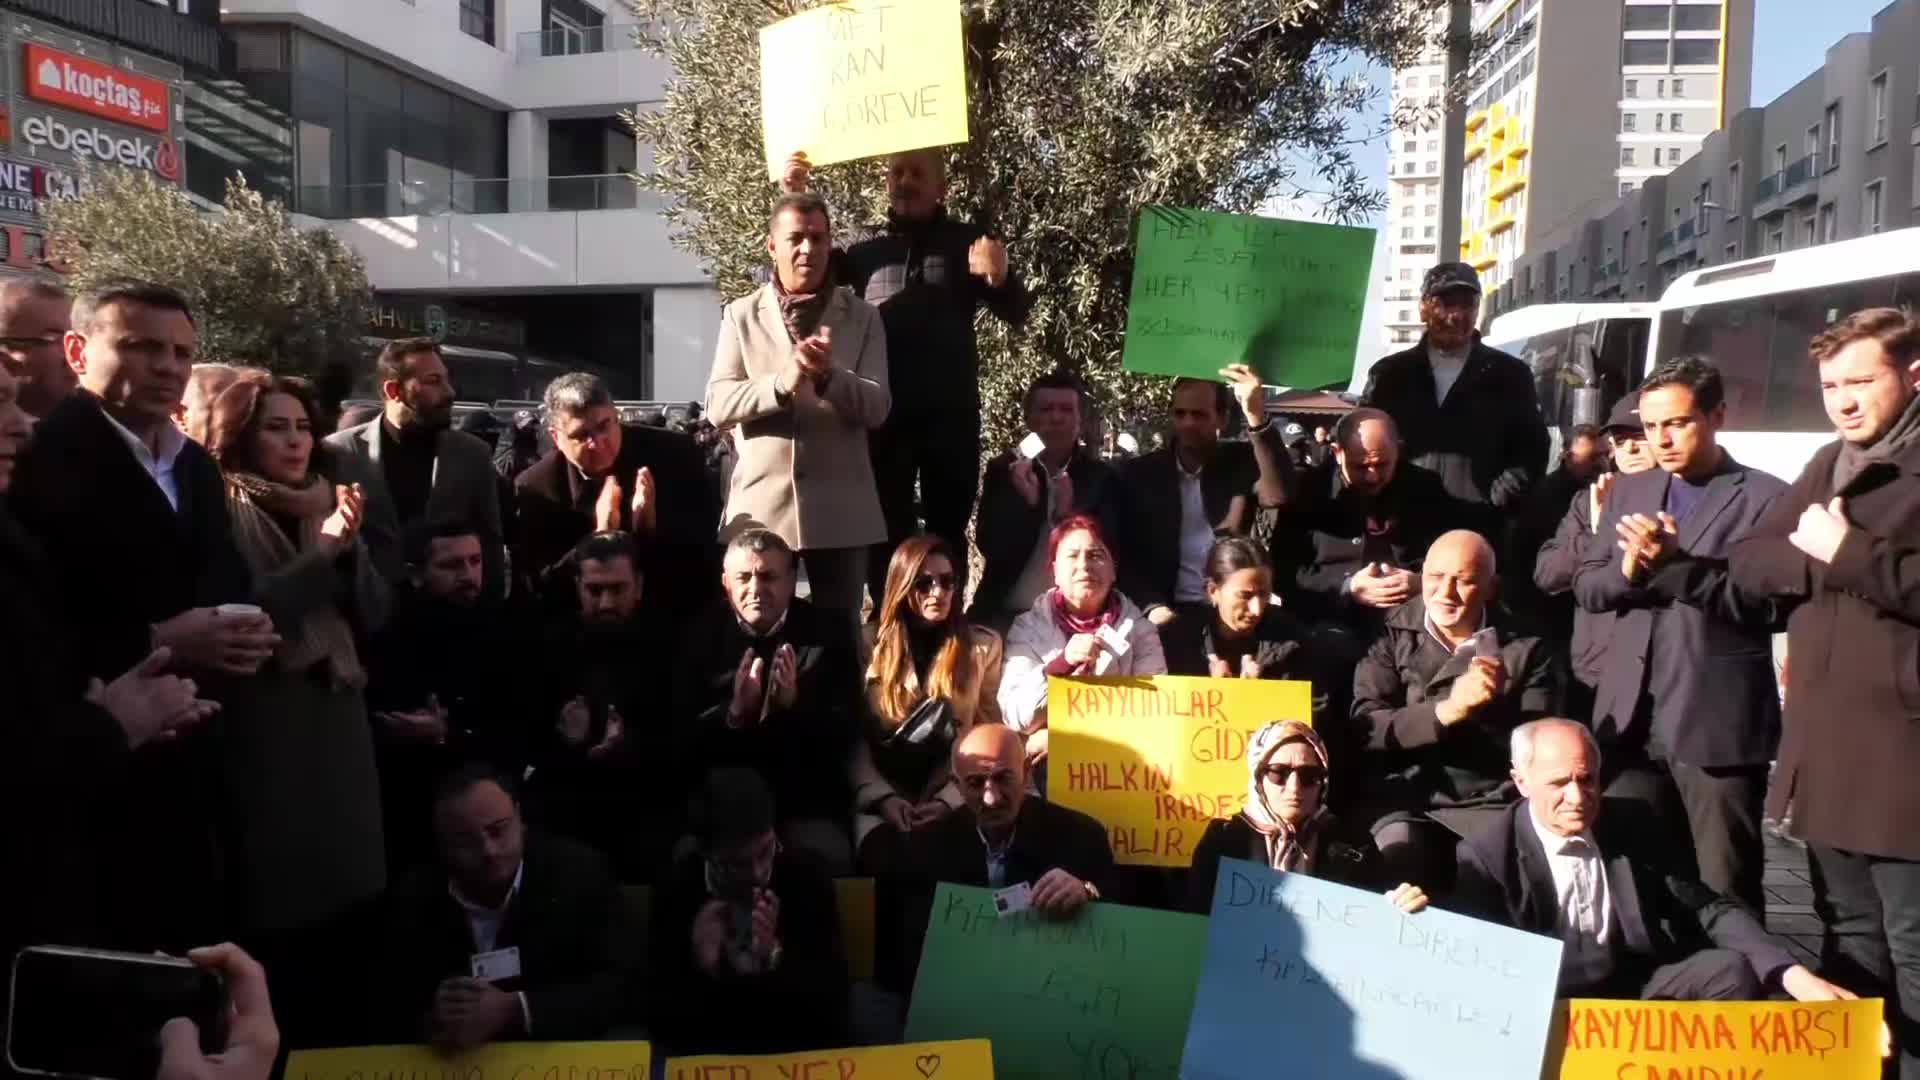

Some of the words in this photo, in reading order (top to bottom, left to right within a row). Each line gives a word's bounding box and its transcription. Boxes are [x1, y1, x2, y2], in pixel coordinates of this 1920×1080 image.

[22, 115, 153, 169] ebebek
[1067, 687, 1228, 722] KAYYUMLAR
[1067, 763, 1173, 792] HALKIN
[1566, 1007, 1737, 1053] KAYYUMA
[1750, 1008, 1850, 1061] KARŞI
